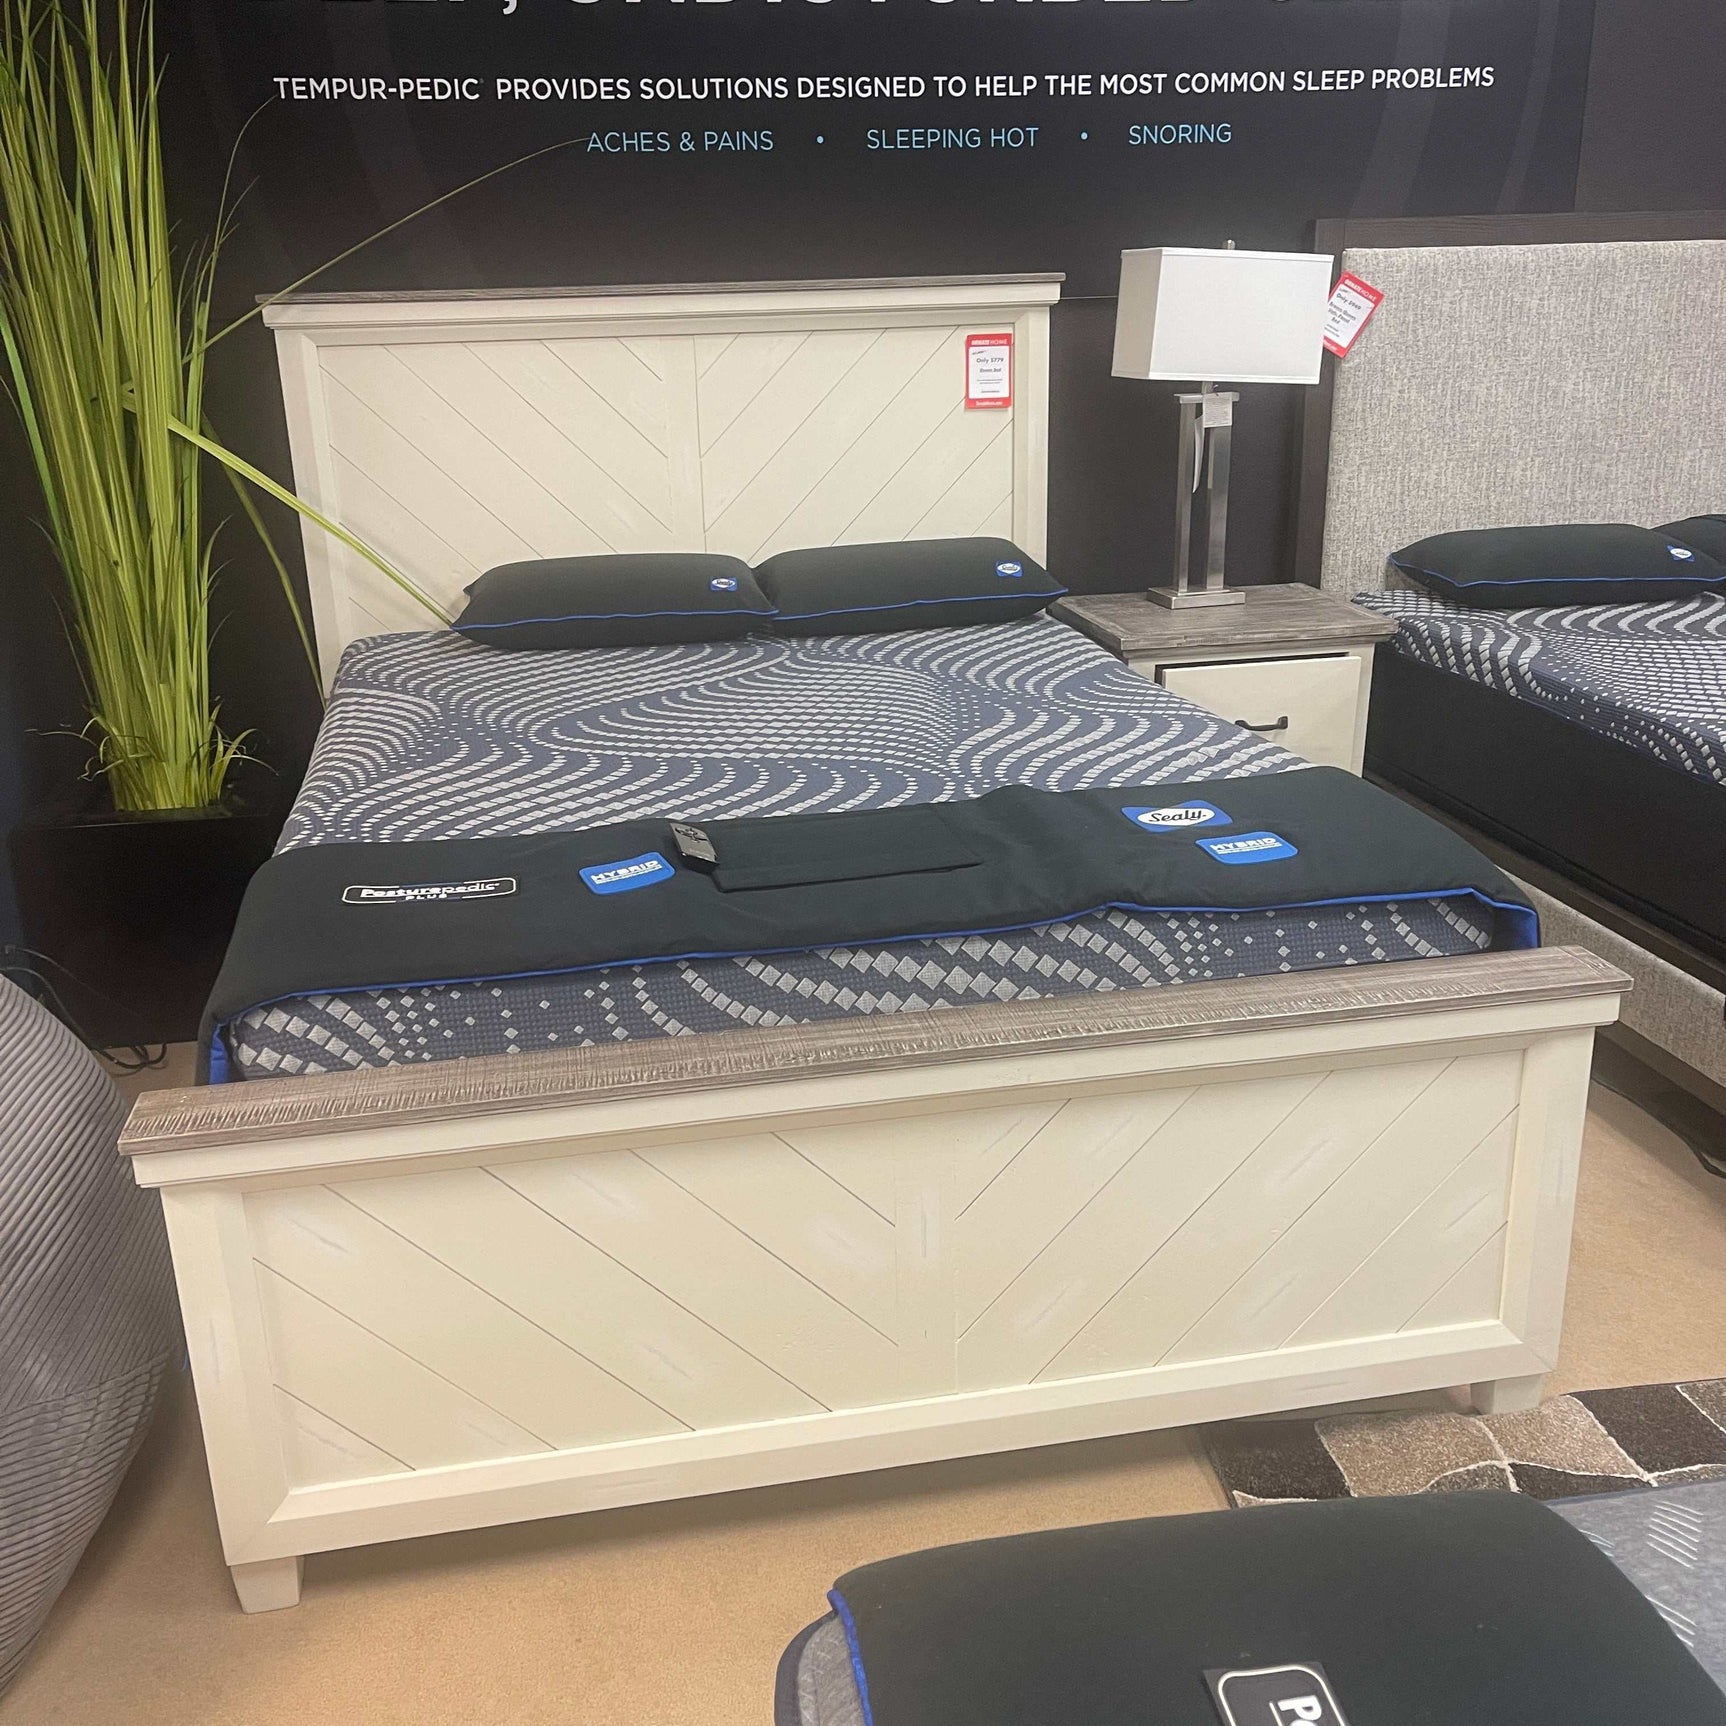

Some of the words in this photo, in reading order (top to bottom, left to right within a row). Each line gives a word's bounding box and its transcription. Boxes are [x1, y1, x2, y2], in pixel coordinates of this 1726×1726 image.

[274, 77, 480, 101] TEMPUR-PEDIC
[496, 78, 631, 100] PROVIDES
[639, 77, 789, 100] SOLUTIONS
[797, 76, 926, 99] DESIGNED
[933, 75, 967, 97] TO
[975, 75, 1038, 97] HELP
[1045, 74, 1092, 96] THE
[1100, 73, 1168, 95] MOST
[1174, 71, 1285, 94] COMMON
[1292, 69, 1365, 92] SLEEP
[1371, 66, 1495, 90] PROBLEMS
[586, 131, 671, 153] ACHES
[679, 131, 696, 152] &
[704, 130, 774, 151] PAINS
[867, 128, 981, 150] SLEEPING
[990, 127, 1040, 148] HOT
[1128, 123, 1232, 146] SNORING
[1149, 809, 1203, 823] Sealy
[1209, 837, 1278, 851] HYBRID
[590, 859, 660, 882] HYBRID
[359, 882, 498, 898] Posturepedic
[405, 893, 448, 901] PLUS
